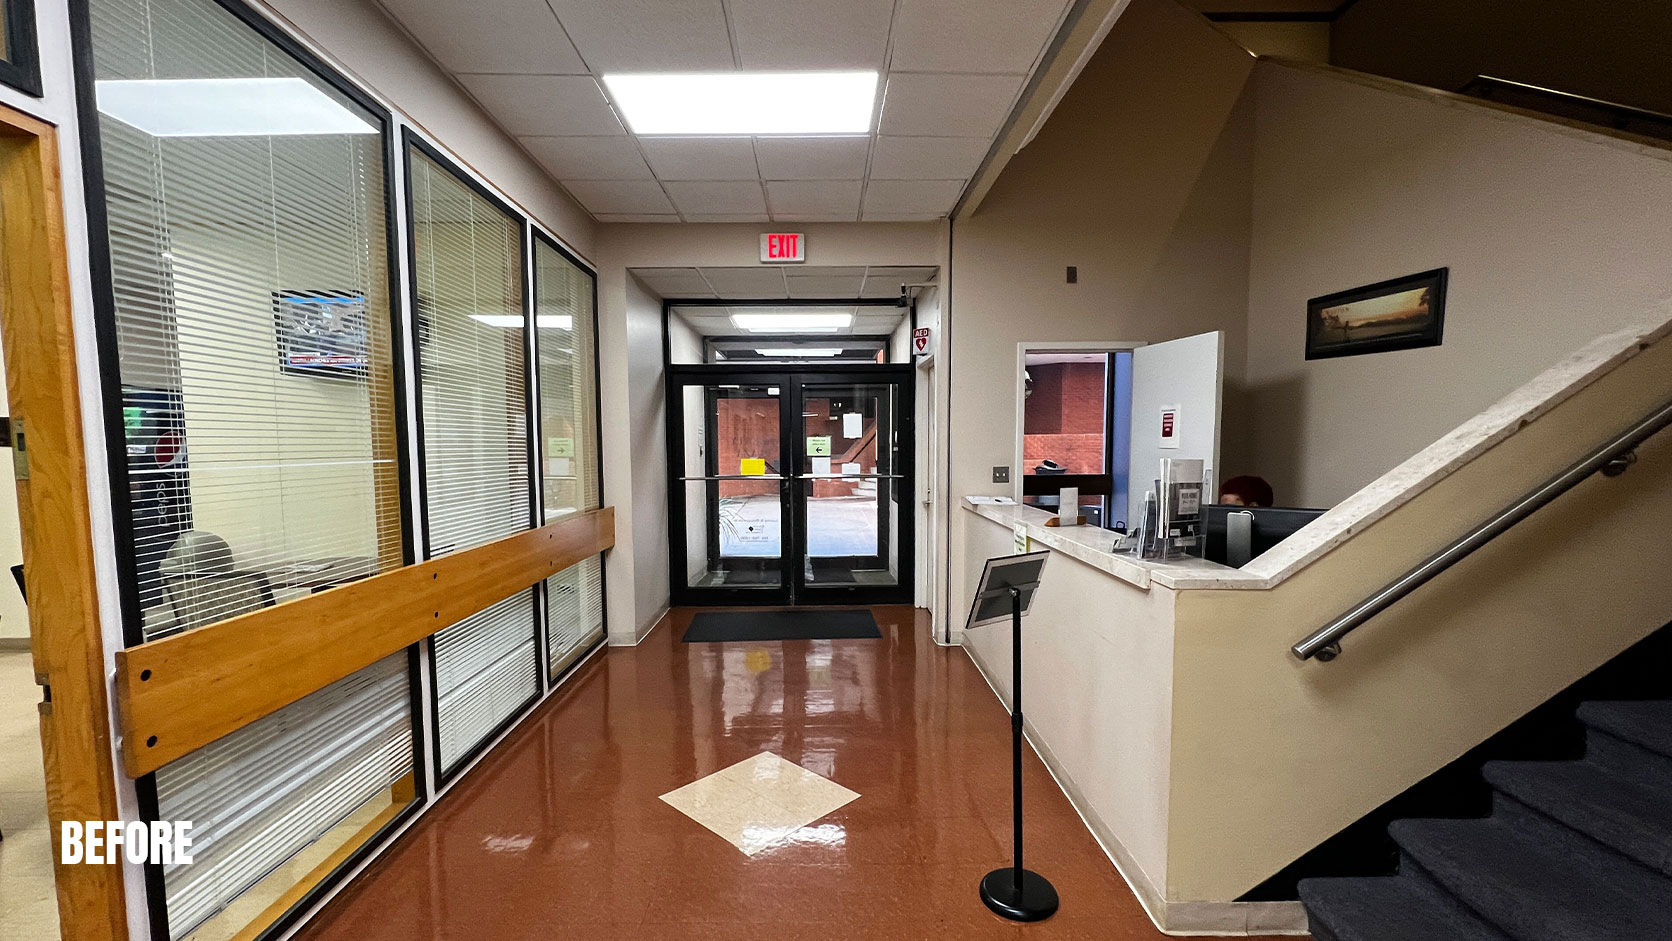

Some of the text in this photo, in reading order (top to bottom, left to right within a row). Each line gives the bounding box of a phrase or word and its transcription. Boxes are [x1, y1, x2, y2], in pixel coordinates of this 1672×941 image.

[768, 234, 798, 258] EXIT
[915, 329, 928, 337] AED
[156, 480, 170, 527] peps
